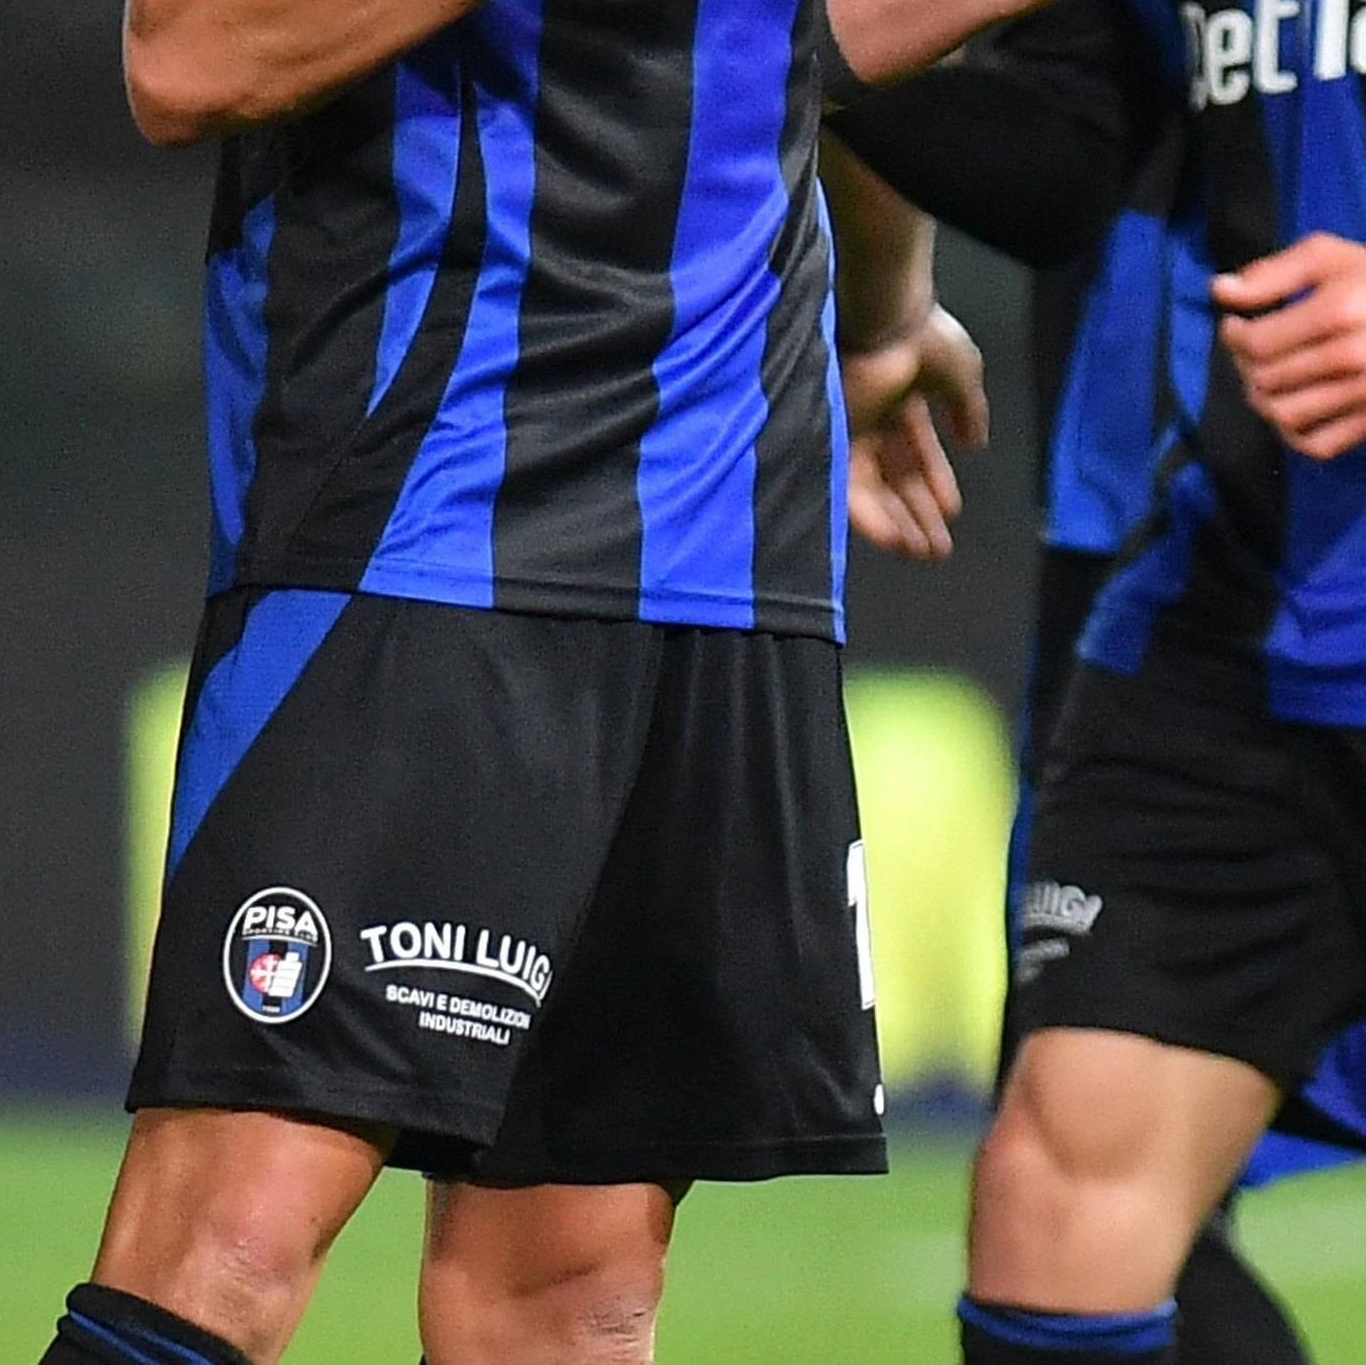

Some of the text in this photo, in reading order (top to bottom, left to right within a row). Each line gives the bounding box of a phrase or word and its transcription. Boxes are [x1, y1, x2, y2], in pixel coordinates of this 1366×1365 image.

[242, 905, 318, 941] PISA
[360, 922, 466, 963] TONI
[386, 984, 435, 1009] SCAVI
[436, 994, 447, 1011] E
[419, 1011, 511, 1045] INDUSTRIALI
